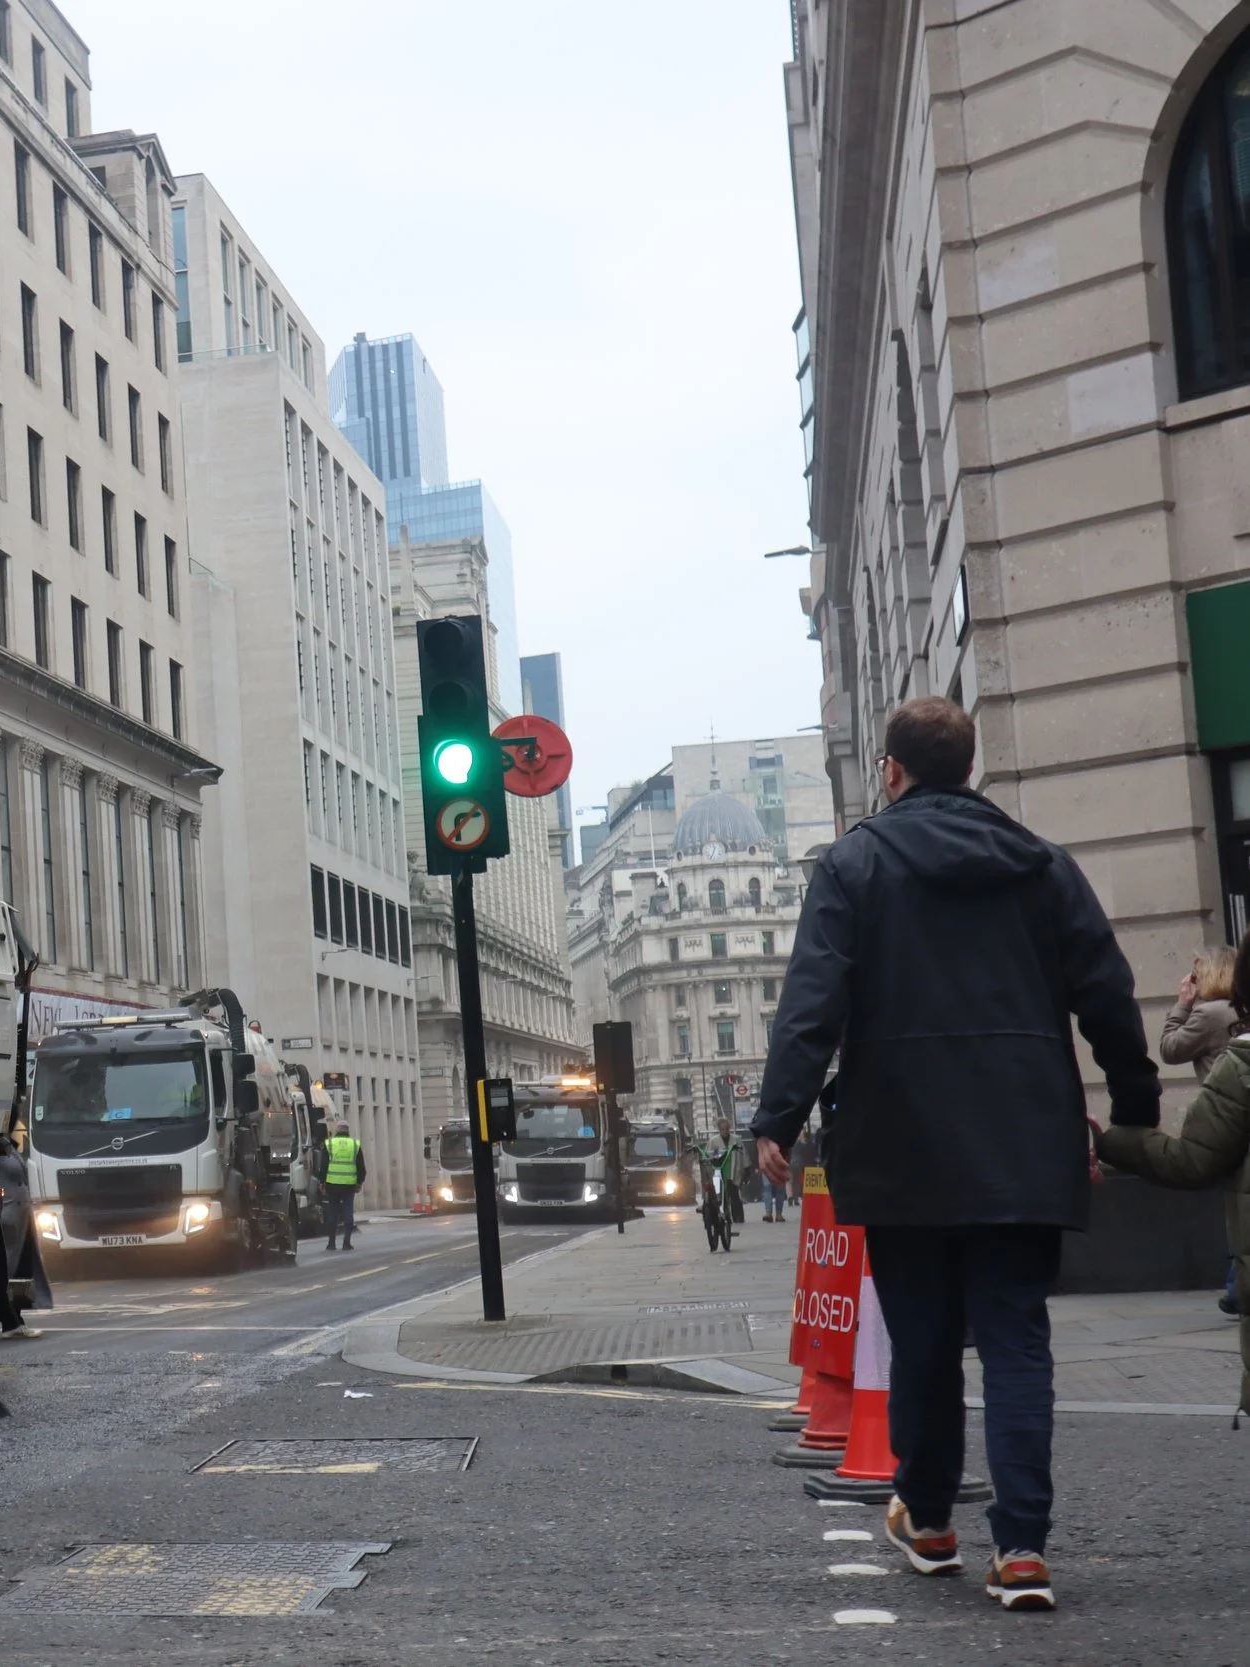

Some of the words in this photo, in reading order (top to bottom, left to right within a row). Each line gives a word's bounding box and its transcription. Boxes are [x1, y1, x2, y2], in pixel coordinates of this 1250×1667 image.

[805, 1174, 823, 1188] EVENT
[805, 1227, 849, 1268] ROAD
[793, 1288, 855, 1333] CLOSED
